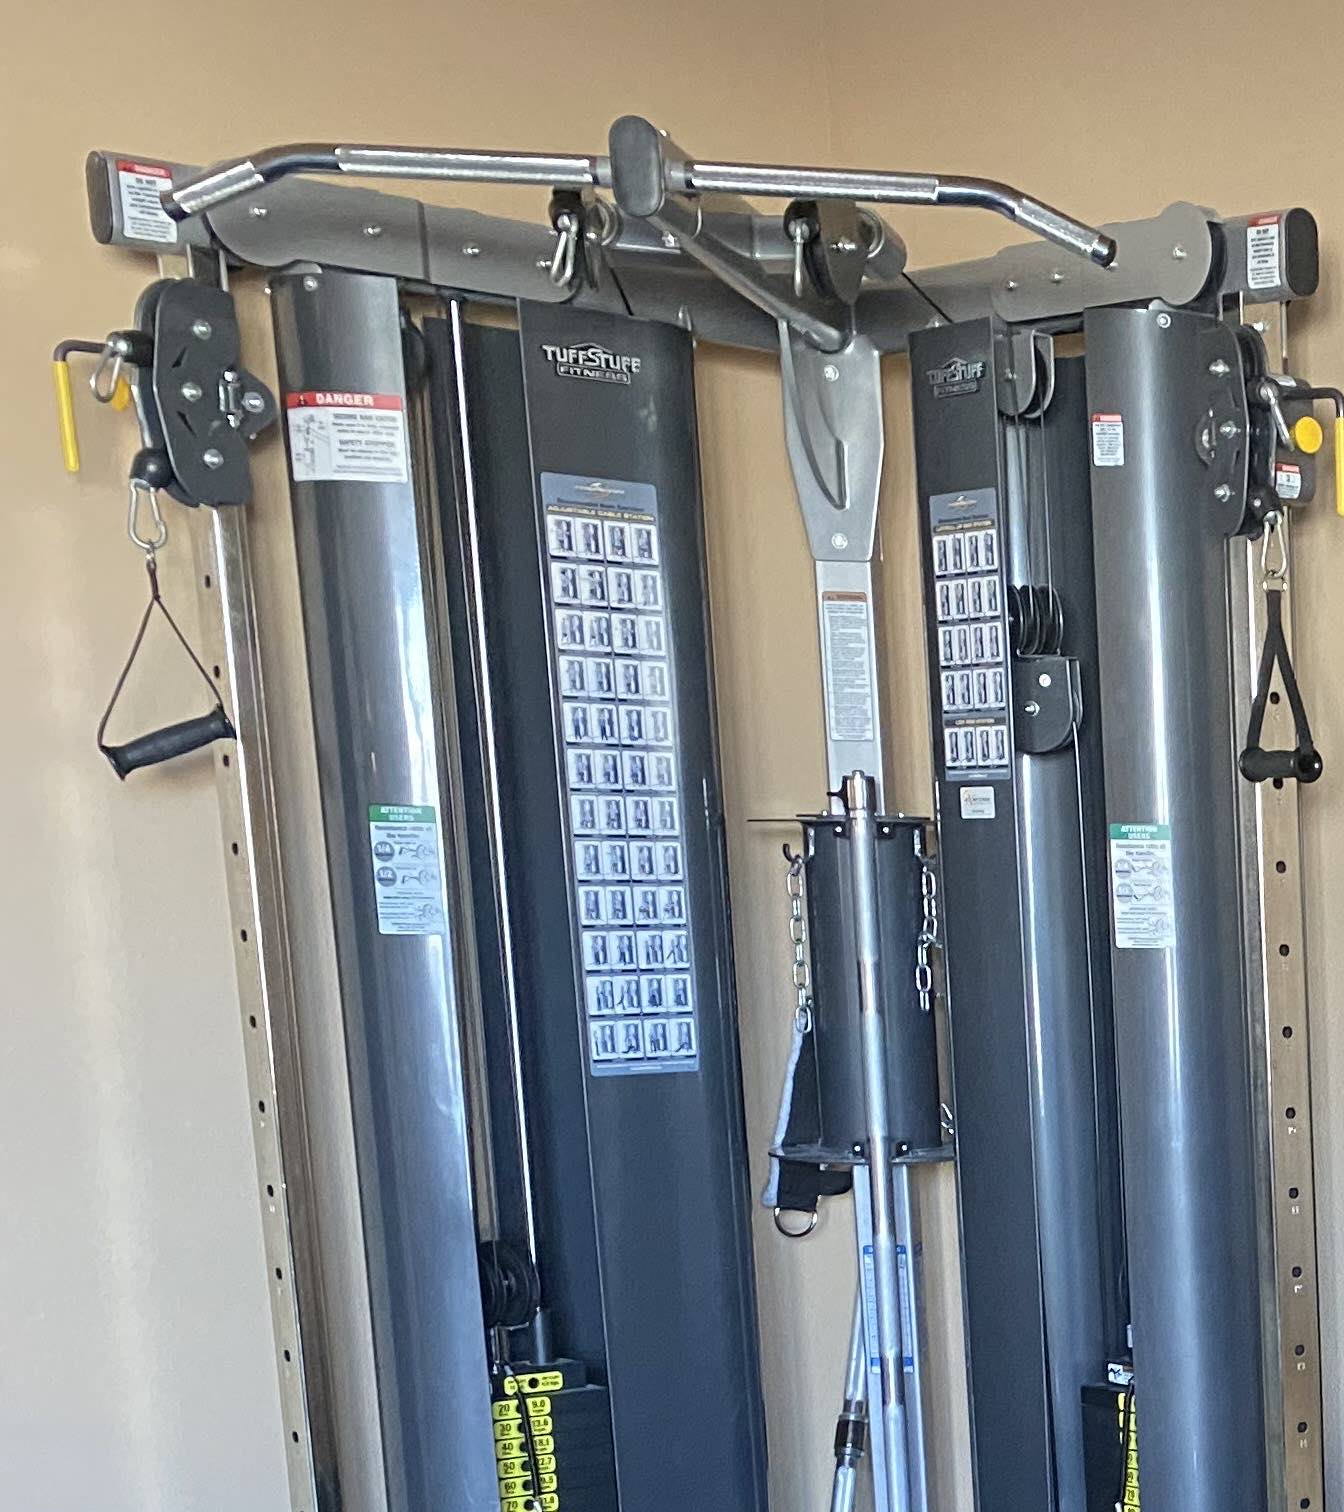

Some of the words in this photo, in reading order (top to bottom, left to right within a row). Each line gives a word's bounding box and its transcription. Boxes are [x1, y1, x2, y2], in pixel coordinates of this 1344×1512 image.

[315, 392, 375, 406] DANGER
[1121, 825, 1158, 833] ATTENTION
[498, 1403, 510, 1413] 20
[502, 1442, 513, 1452] 40
[503, 1461, 515, 1471] 50
[506, 1501, 518, 1510] 70
